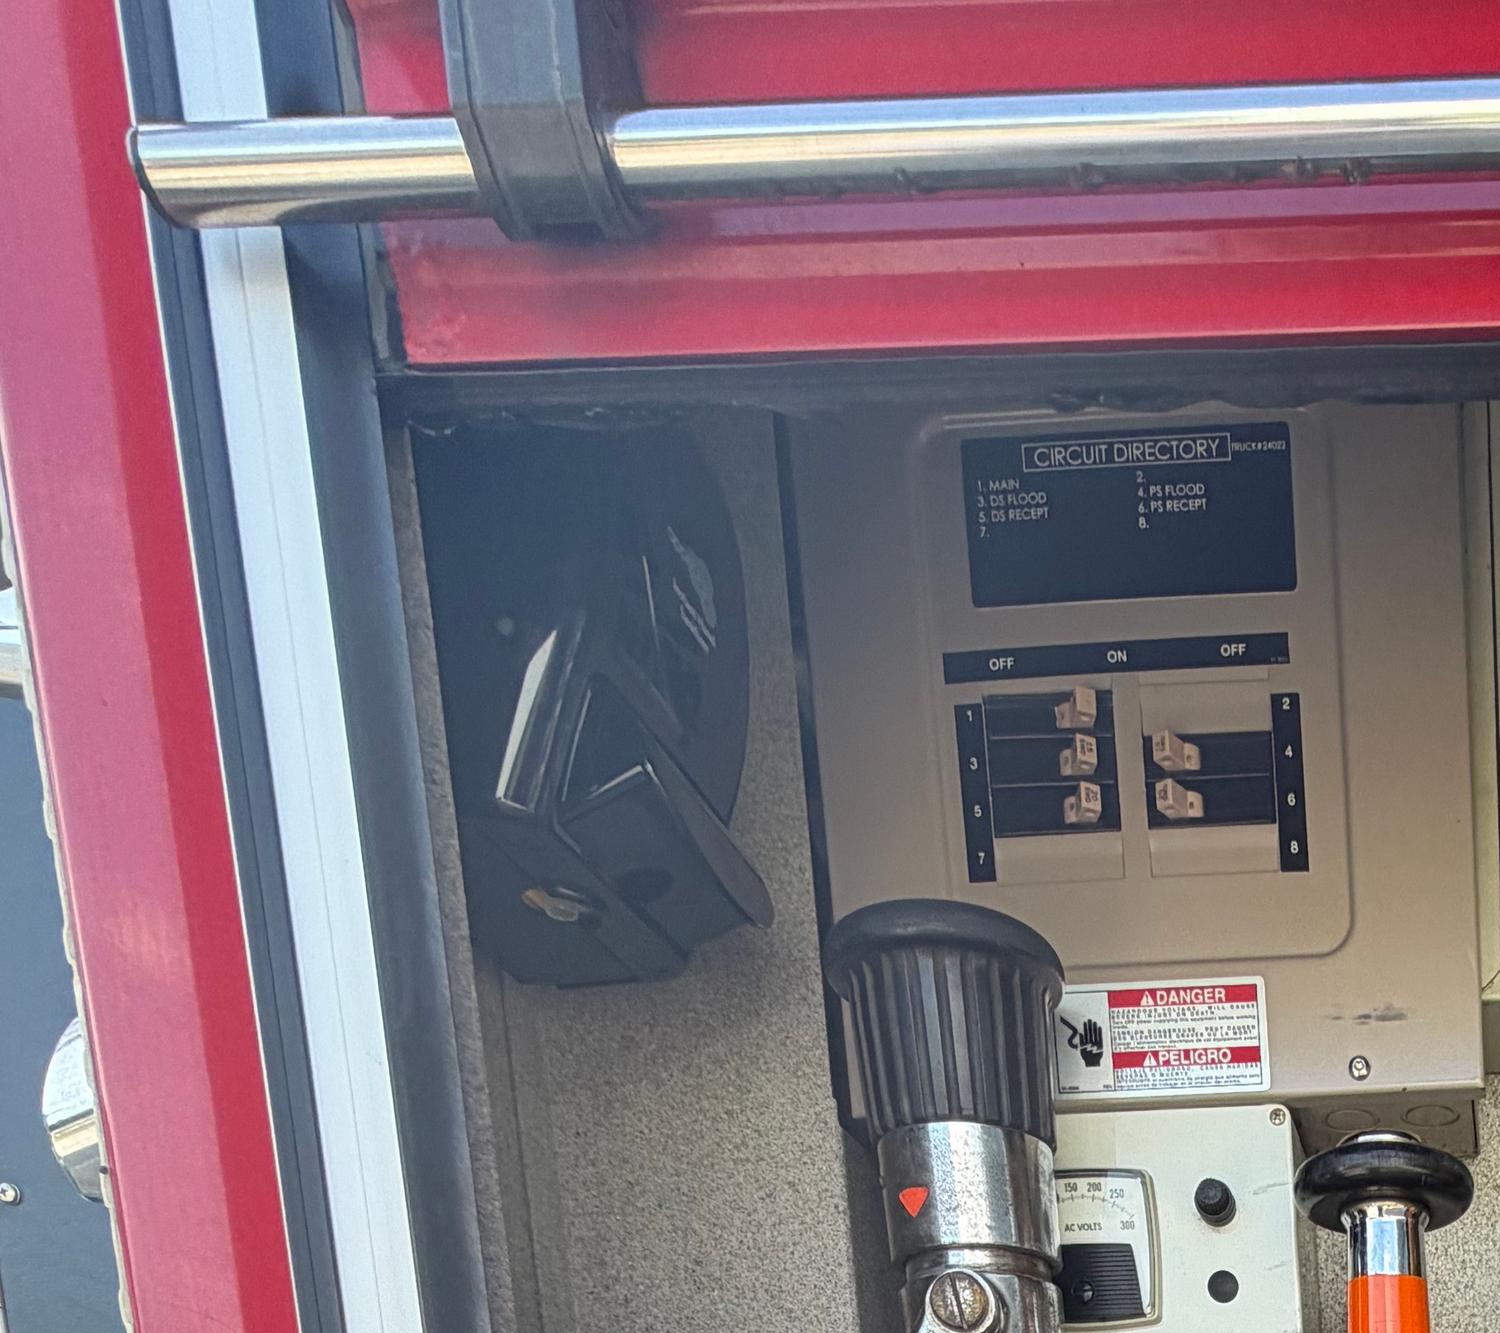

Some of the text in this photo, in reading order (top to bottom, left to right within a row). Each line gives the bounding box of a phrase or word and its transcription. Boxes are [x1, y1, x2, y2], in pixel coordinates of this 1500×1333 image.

[1033, 438, 1220, 468] CIRCUIT DIRECTORY
[989, 479, 1019, 491] MAIN
[1149, 484, 1162, 497] PS
[1165, 483, 1205, 496] FLOOD
[990, 494, 1005, 507] DS
[1007, 491, 1047, 506] FLOOD
[1150, 500, 1163, 513] PS
[1166, 498, 1207, 512] RECEPT
[991, 509, 1006, 522] DS
[1008, 507, 1048, 521] RECEPT
[1138, 516, 1149, 529] 8.
[988, 643, 1247, 673] OFF ON OFF
[1281, 697, 1290, 710] 2
[966, 709, 973, 722] 1
[1284, 745, 1293, 758] 4
[970, 757, 978, 770] 3
[1287, 793, 1296, 806] 6
[973, 804, 982, 817] 5
[1290, 840, 1299, 854] 8
[978, 852, 986, 865] 7
[1155, 987, 1227, 1006] DANGER
[1158, 1048, 1232, 1066] PELIGRO
[1064, 1182, 1135, 1231] 150 200 250 300
[1064, 1222, 1103, 1232] AC VOLTS
